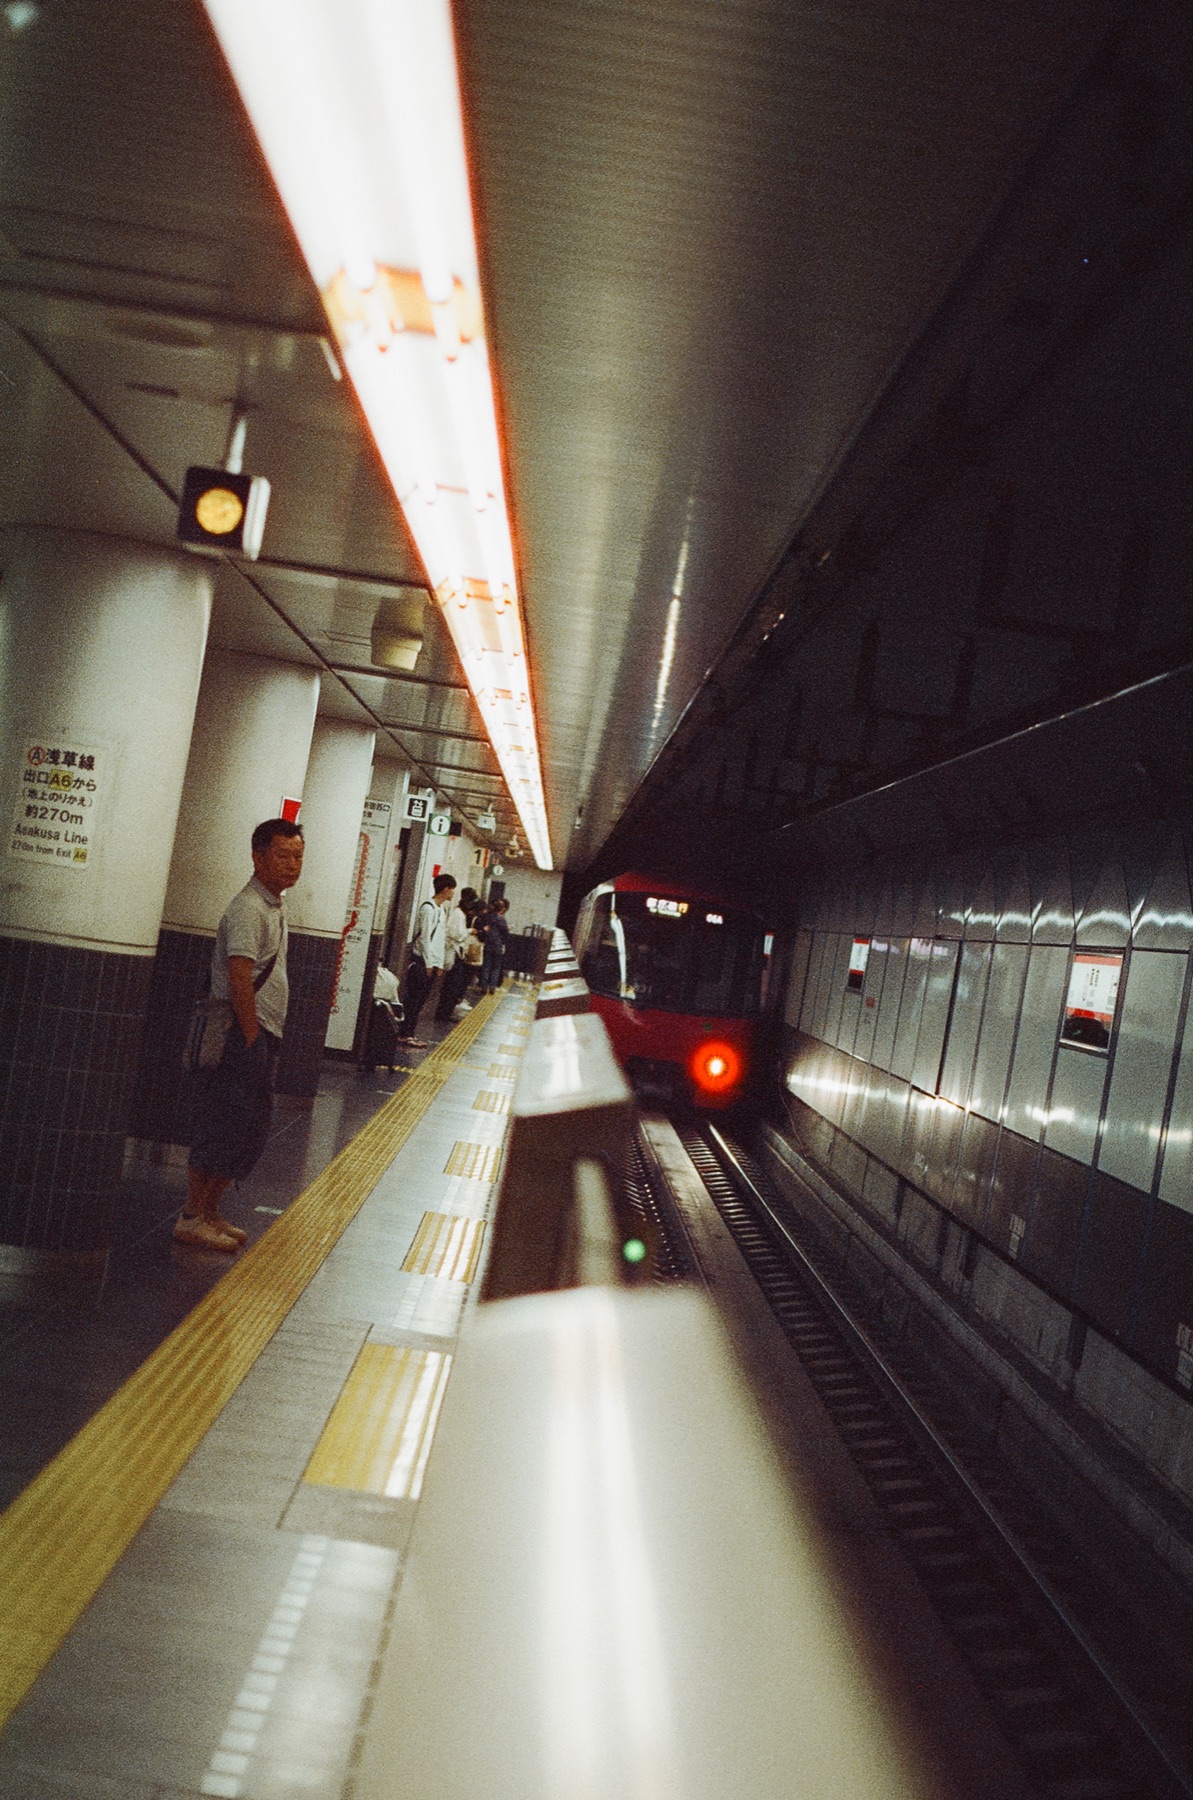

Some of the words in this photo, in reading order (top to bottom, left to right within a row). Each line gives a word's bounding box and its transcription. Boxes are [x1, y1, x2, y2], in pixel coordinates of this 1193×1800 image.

[23, 768, 97, 792] 出口A6から
[24, 804, 84, 825] 約270m
[14, 823, 60, 841] Asakusa
[64, 830, 88, 845] Line
[36, 845, 54, 855] from
[56, 847, 71, 859] Exit
[73, 850, 87, 861] A6
